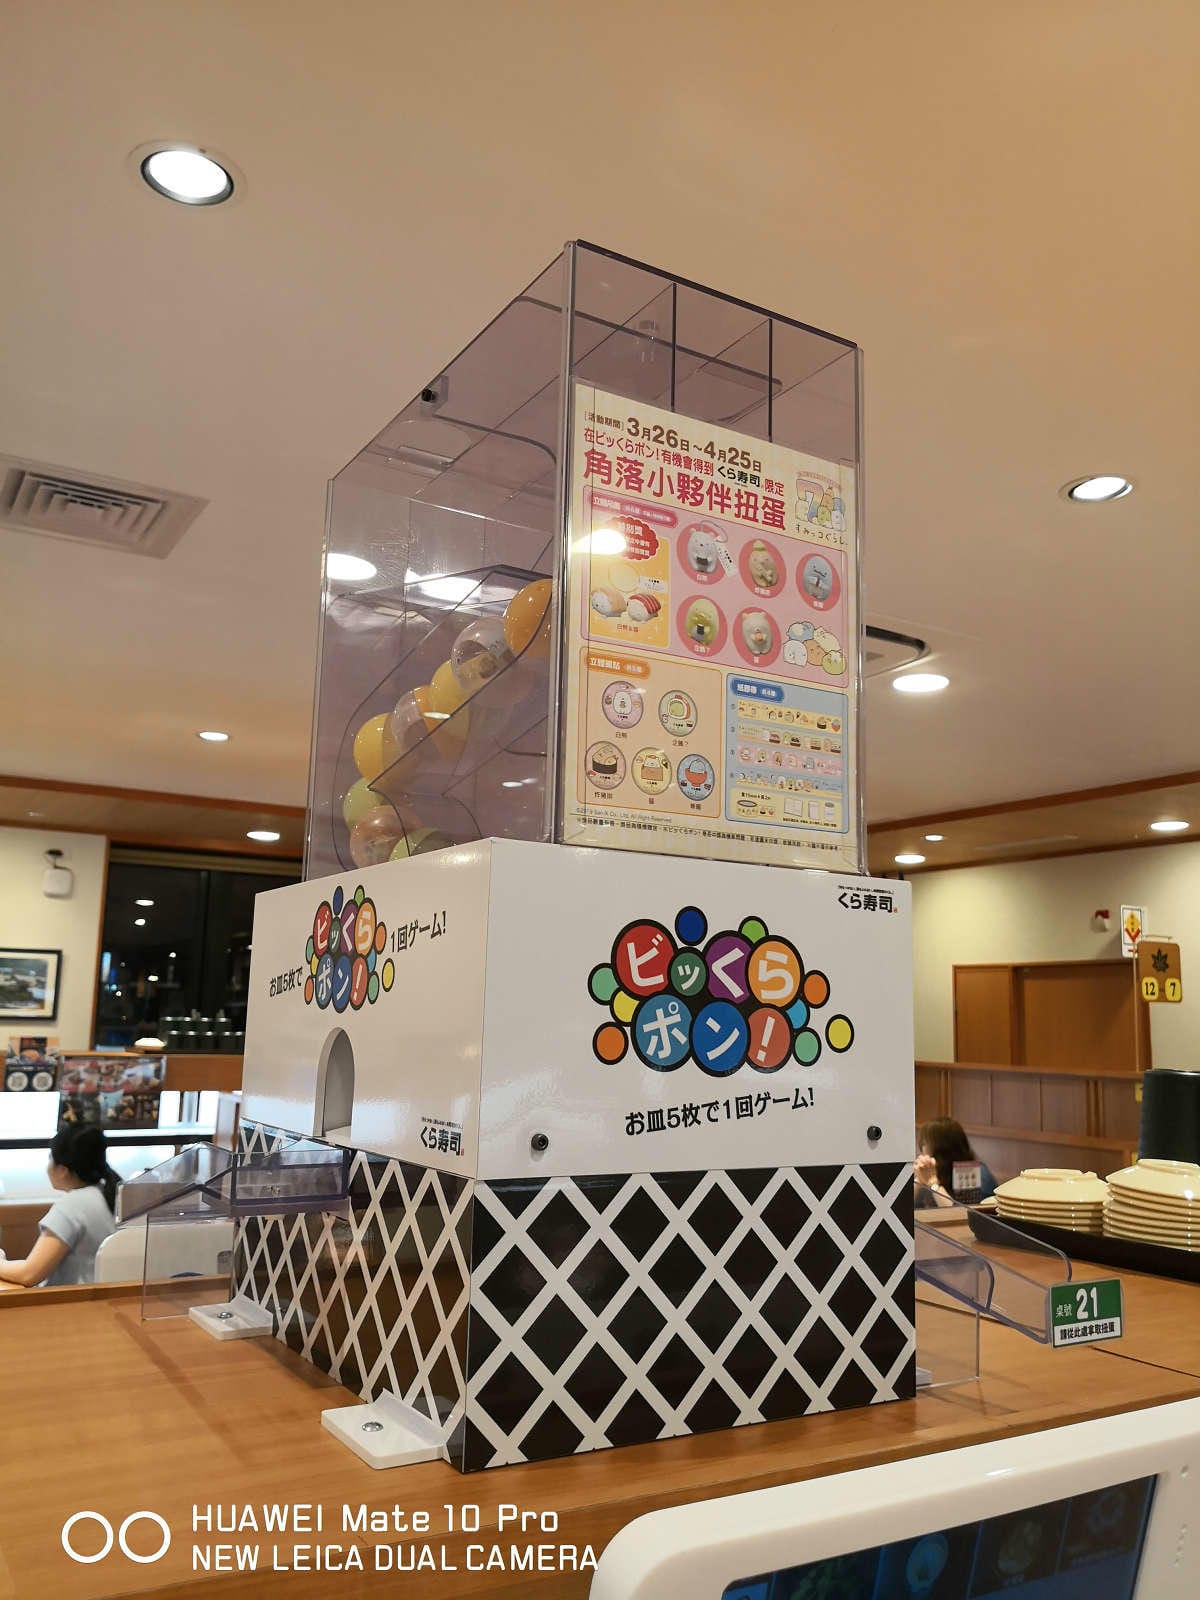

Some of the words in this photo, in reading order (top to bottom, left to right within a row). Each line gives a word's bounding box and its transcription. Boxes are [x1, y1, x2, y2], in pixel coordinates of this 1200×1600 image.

[584, 448, 786, 531] 角落小夥伴扭蛋
[764, 479, 785, 497] 限定
[838, 893, 893, 913] くら寿司
[317, 910, 371, 952] ビッくら
[391, 910, 446, 953] 1回ゲーム!
[270, 967, 303, 997] お皿5枚で
[626, 934, 793, 1000] ビッくら
[1145, 982, 1156, 996] 12
[1169, 982, 1176, 997] 7
[642, 1001, 776, 1062] ポン!
[625, 1088, 815, 1136] お皿5枚で1回ゲーム!
[420, 1126, 462, 1156] くら寿司
[1076, 1286, 1098, 1320] 21
